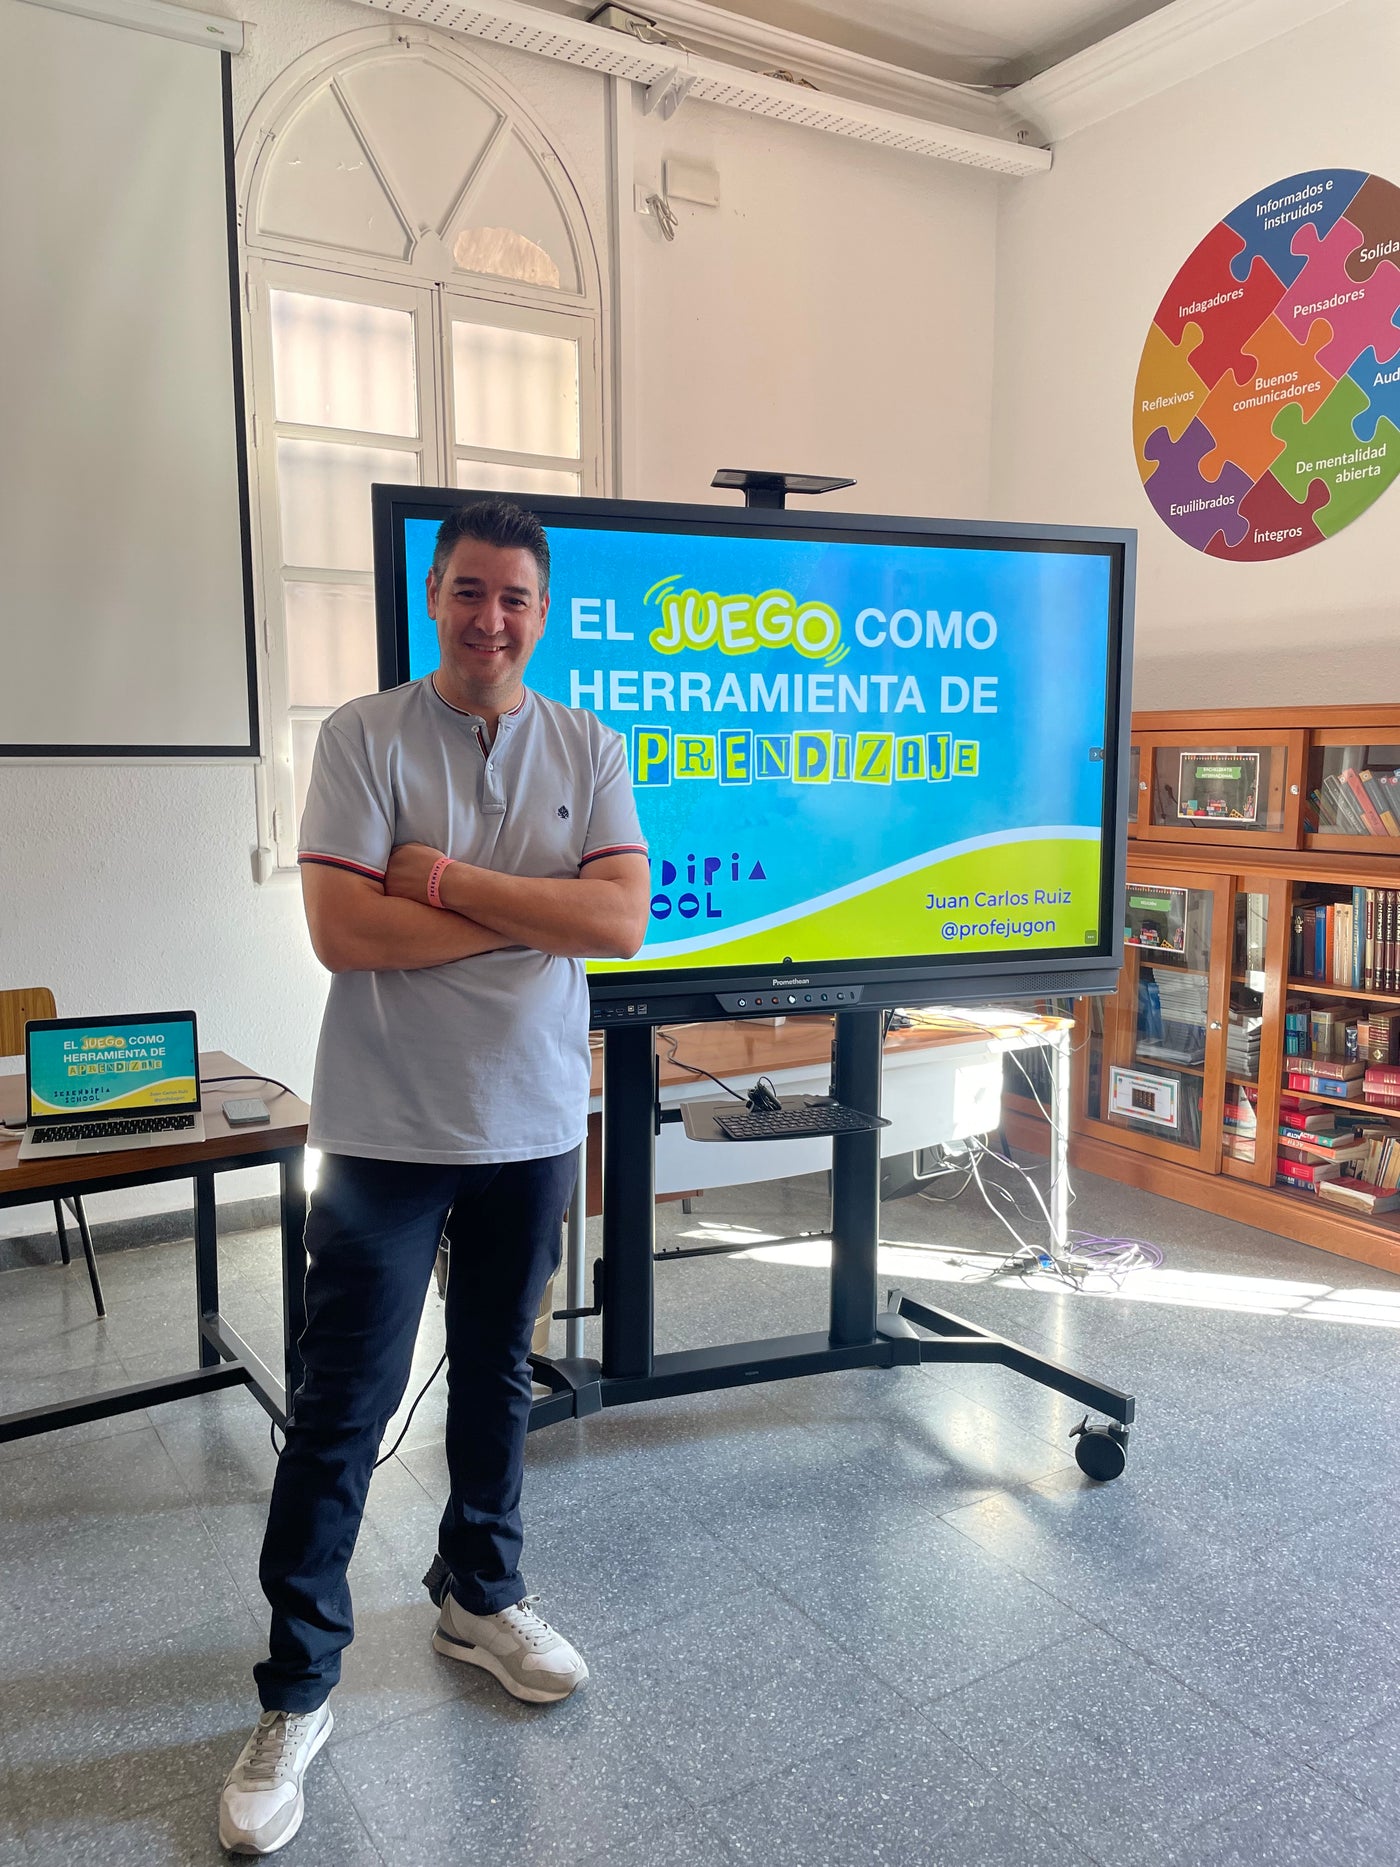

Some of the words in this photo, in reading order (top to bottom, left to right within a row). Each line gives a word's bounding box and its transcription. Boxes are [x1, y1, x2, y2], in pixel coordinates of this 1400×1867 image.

[1256, 182, 1323, 216] Informados
[1325, 180, 1333, 190] e
[1264, 200, 1323, 230] instruidos
[1360, 240, 1400, 263] Solida
[1179, 288, 1244, 318] Indagadores
[1293, 288, 1365, 318] Pensadores
[1255, 371, 1299, 391] Buenos
[1373, 367, 1400, 387] Aud
[1142, 390, 1195, 413] Reflexivos
[1233, 380, 1321, 412] comunicadores
[1296, 461, 1313, 474] De
[1315, 443, 1387, 471] mentalidad
[1335, 464, 1381, 483] abierta
[1170, 494, 1235, 516] Equilibrados
[1253, 526, 1303, 544] Íntegros
[571, 597, 634, 641] EL
[653, 591, 838, 656] JUEGO
[854, 607, 998, 650] COMO
[569, 669, 927, 713] HERRAMIENTA
[940, 676, 999, 714] DE
[633, 727, 979, 786] PRENDIZAJE
[649, 852, 767, 886] DiPiA
[925, 893, 969, 910] Juan
[974, 890, 1029, 908] Carlos
[1034, 888, 1072, 905] Ruiz
[941, 918, 1056, 941] @profejugon
[772, 978, 810, 986] Promethean
[63, 1041, 78, 1050] EL
[82, 1036, 126, 1050] JUEGO
[128, 1034, 165, 1045] COMO
[63, 1049, 148, 1063] HERRAMIENTA
[150, 1047, 166, 1057] DE
[68, 1060, 162, 1077] APRENDIZAJE
[65, 1095, 100, 1104] SCHOOL
